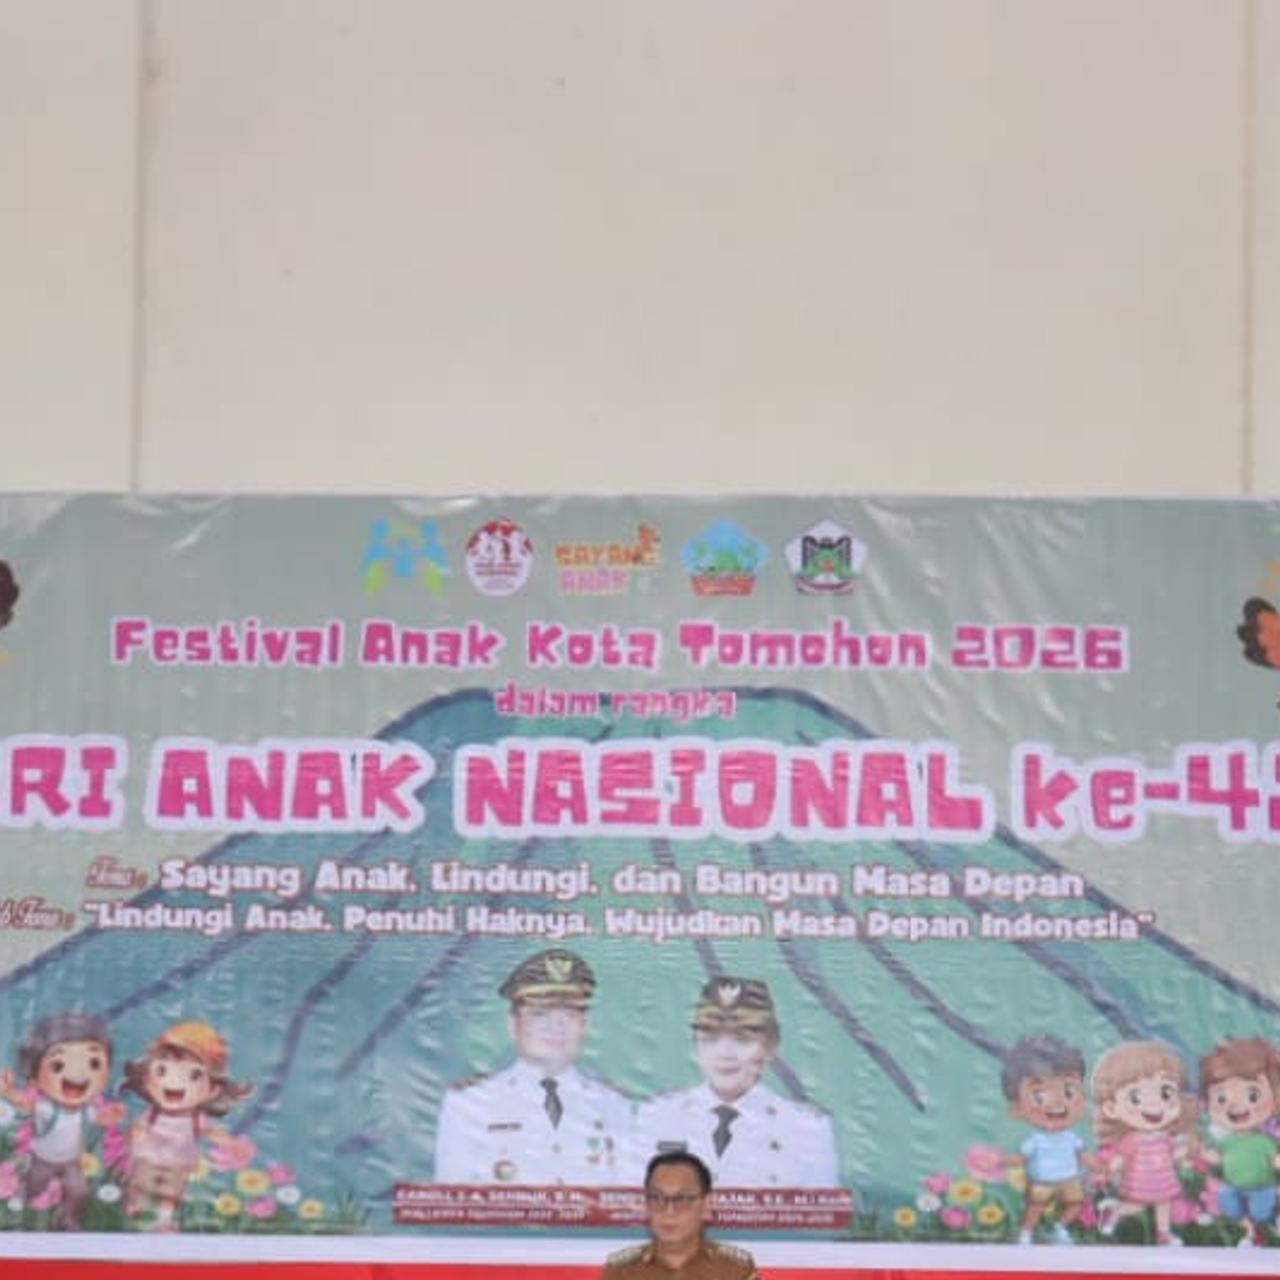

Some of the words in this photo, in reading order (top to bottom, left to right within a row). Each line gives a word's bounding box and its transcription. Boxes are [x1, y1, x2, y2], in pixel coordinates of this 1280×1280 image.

[114, 619, 341, 665] Festival
[362, 622, 500, 667] Anak
[528, 624, 656, 668] Kota
[679, 620, 926, 668] Tomohon
[953, 626, 1125, 671] 2026
[495, 682, 600, 714] dalam
[611, 685, 736, 719] rangka
[157, 748, 423, 823] ANAK
[465, 748, 983, 831] NASIONAL
[160, 859, 301, 897] Sayang
[613, 863, 682, 894] dan
[696, 863, 840, 903] Bangun
[852, 866, 951, 896] Masa
[964, 866, 1085, 901] Depan
[343, 904, 455, 932] Penuhi
[604, 906, 762, 942] Wujudkan
[772, 909, 858, 937] Masa
[869, 911, 970, 941] Depan
